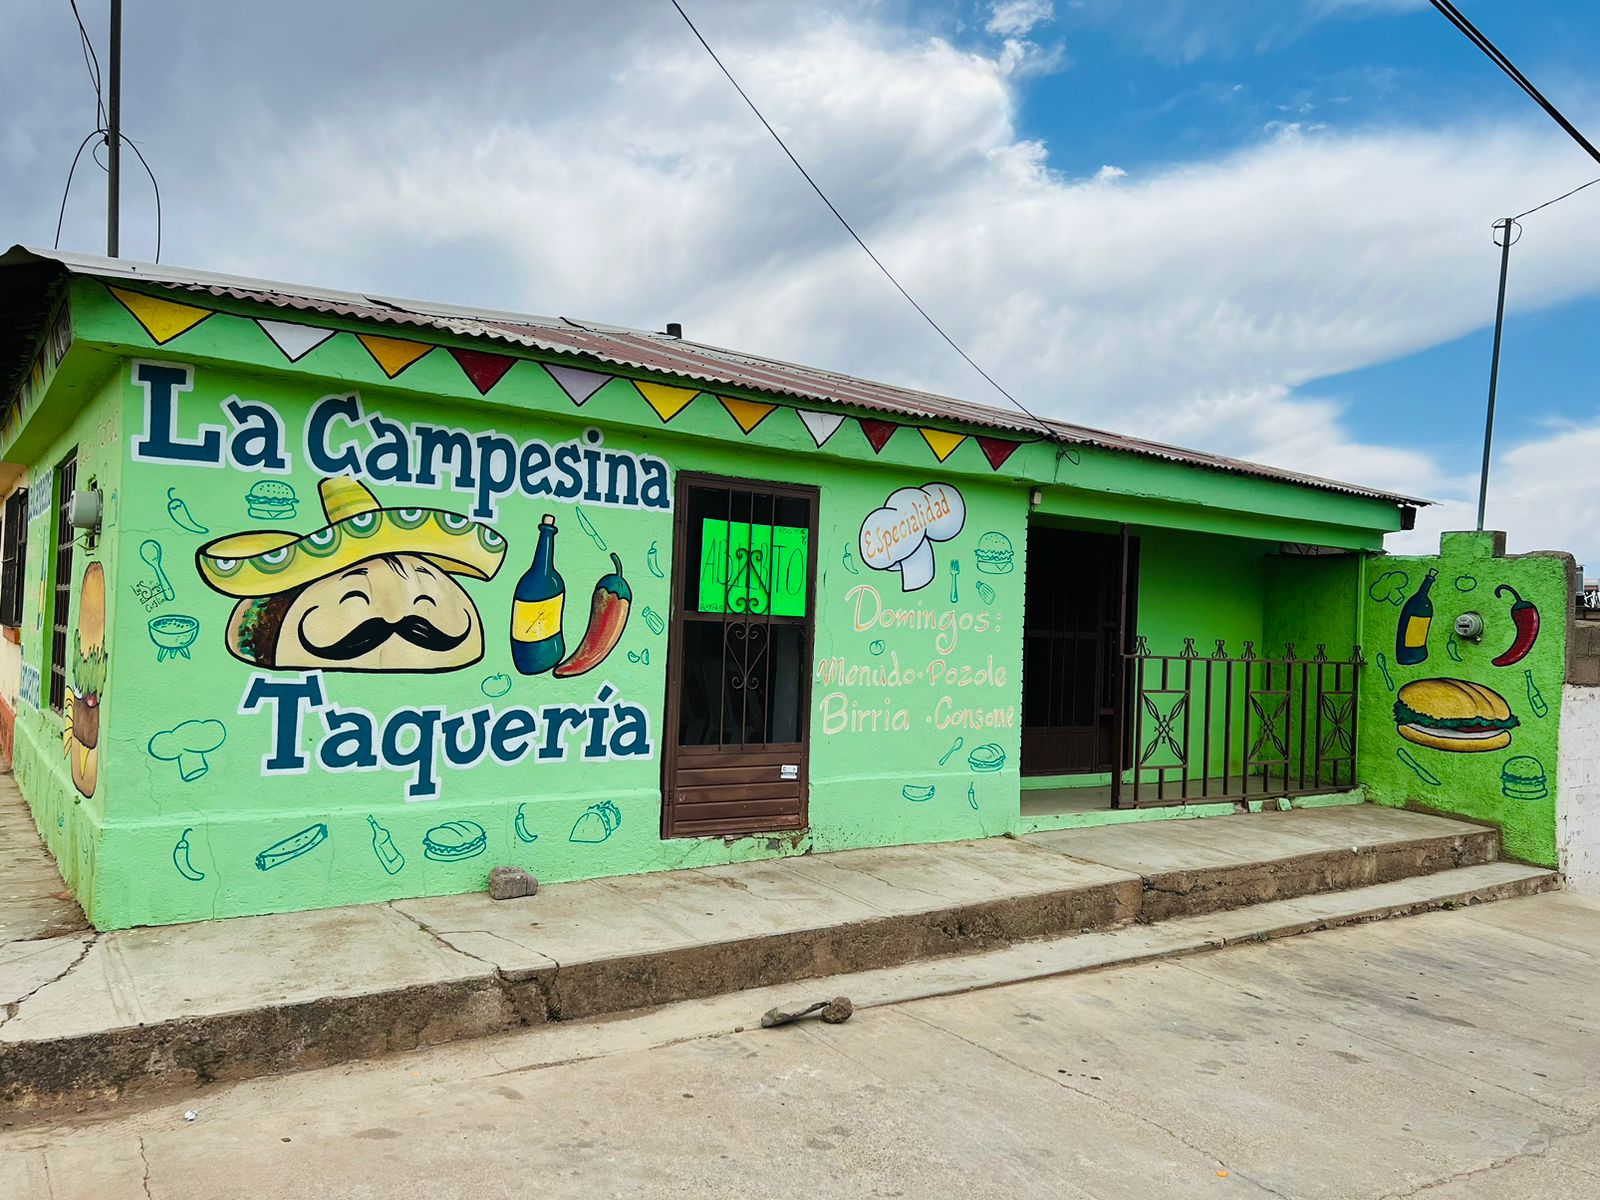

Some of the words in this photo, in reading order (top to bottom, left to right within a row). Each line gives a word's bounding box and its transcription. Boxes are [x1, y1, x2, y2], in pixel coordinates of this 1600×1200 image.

[134, 361, 290, 472] La
[305, 391, 674, 521] Campesina
[864, 487, 951, 561] Especialidad
[240, 672, 653, 799] Taquería
[819, 691, 910, 735] Birria
